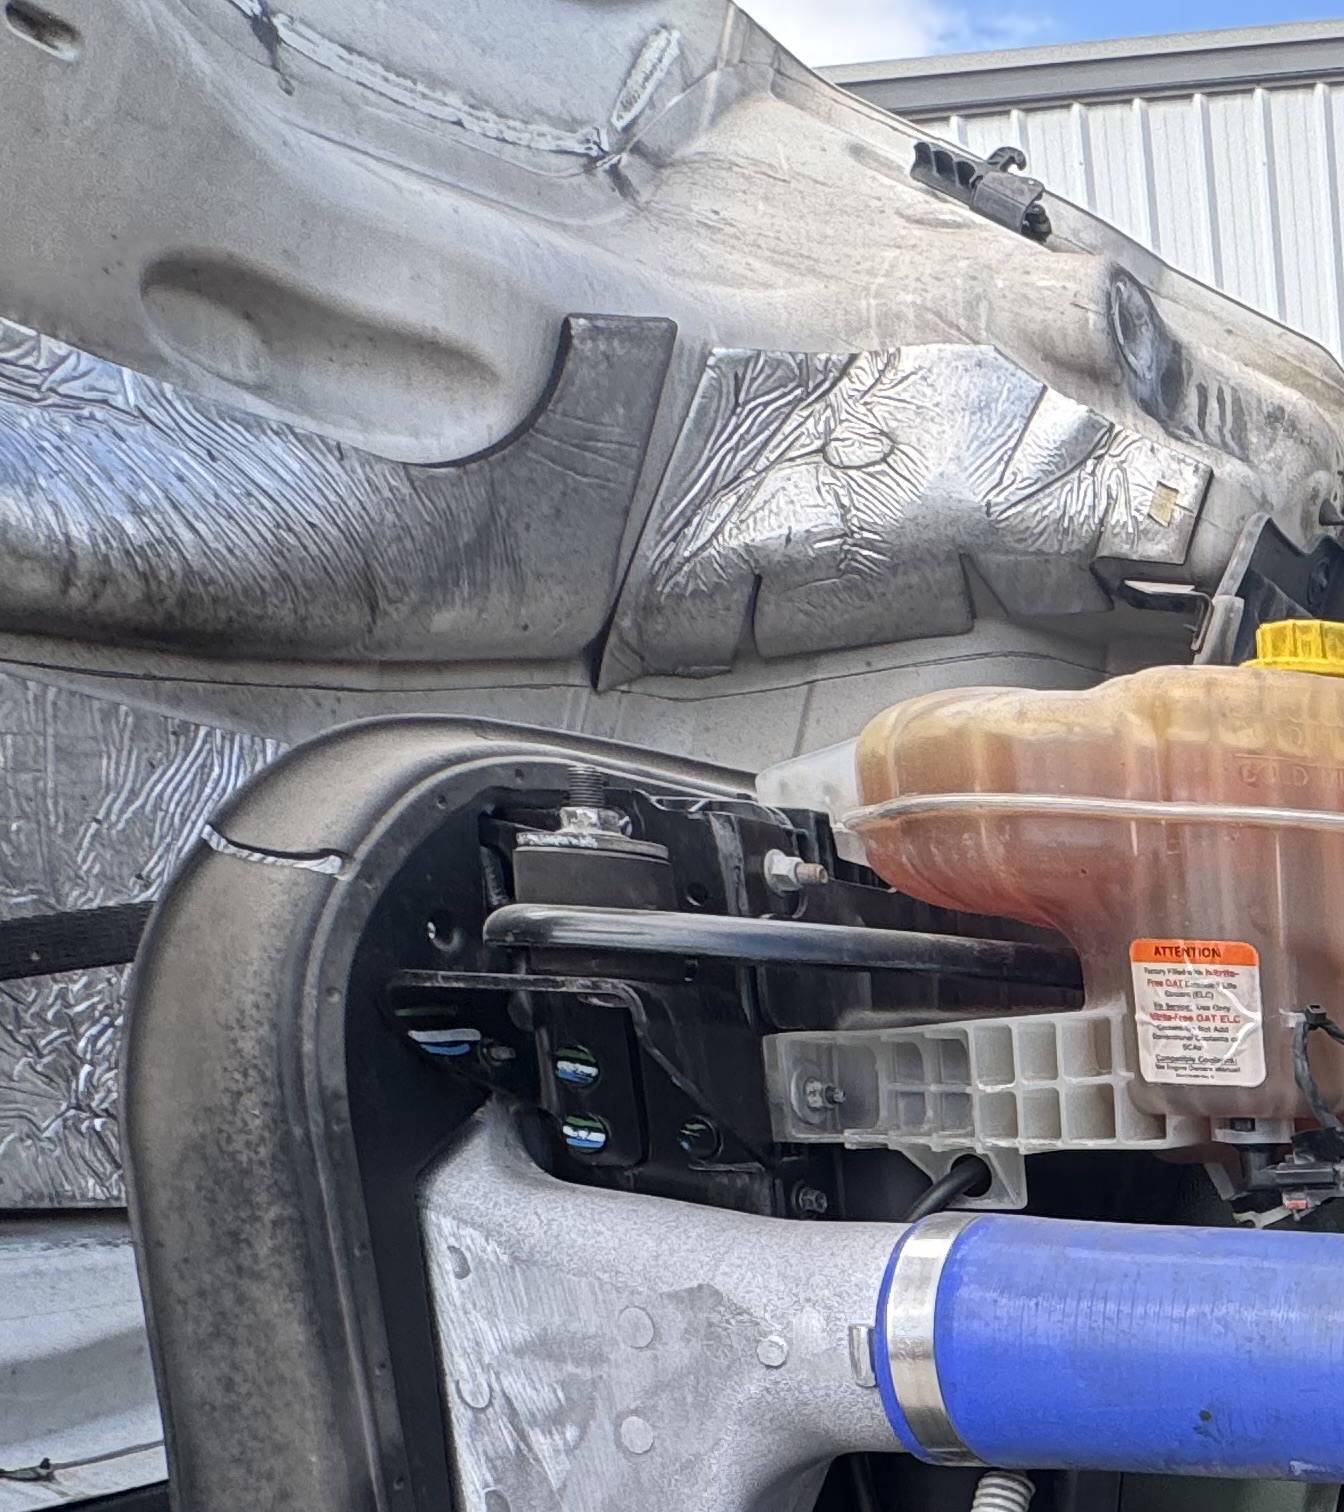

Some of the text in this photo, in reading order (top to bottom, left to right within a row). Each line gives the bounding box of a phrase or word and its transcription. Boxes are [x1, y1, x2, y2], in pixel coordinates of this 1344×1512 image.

[1154, 946, 1221, 958] ATTENTION
[1147, 979, 1163, 987] Free
[1166, 980, 1184, 988] OAT
[1196, 1014, 1217, 1023] OAT
[1220, 1015, 1241, 1023] ELC
